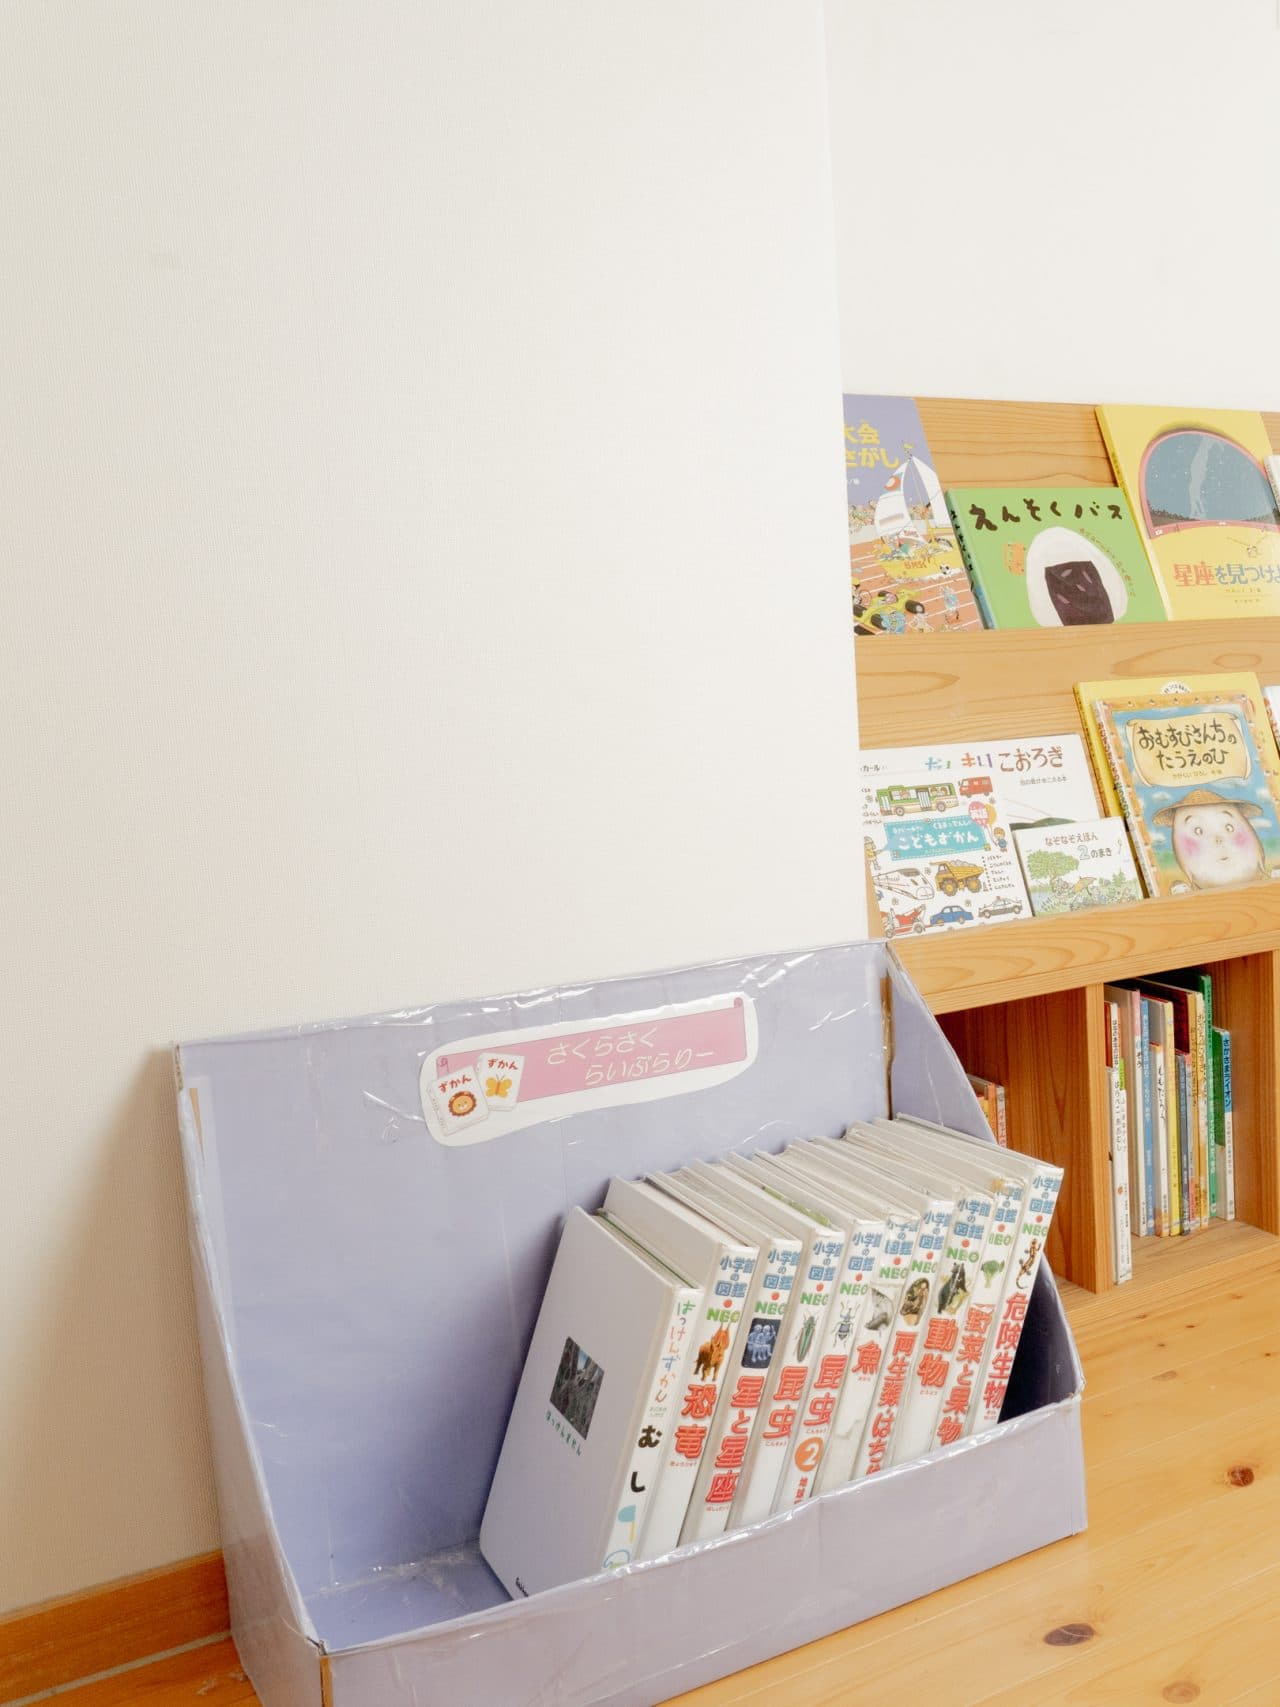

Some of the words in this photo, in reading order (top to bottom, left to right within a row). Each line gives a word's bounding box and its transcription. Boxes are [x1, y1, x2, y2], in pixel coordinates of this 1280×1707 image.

[969, 498, 1123, 532] えんそくバス
[1138, 717, 1238, 751] おむすびさんちの
[1156, 748, 1229, 771] たうえのひ
[1045, 832, 1099, 846] なぞなぞえほん
[487, 1056, 519, 1071] ずかん
[546, 1027, 659, 1065] さくらさく
[438, 1074, 473, 1094] ずかん
[584, 1048, 715, 1087] らいぶらりー
[879, 1267, 910, 1280] NEO
[946, 1246, 980, 1263] NEO
[655, 1300, 697, 1403] はっけんずかん
[852, 1340, 882, 1375] 魚
[917, 1317, 959, 1388] 動物
[983, 1291, 1028, 1409] 危険生物
[803, 1354, 849, 1428] 昆虫
[937, 1302, 996, 1446] 野菜と果物
[675, 1383, 717, 1460] 恐竜
[763, 1365, 809, 1440] 昆虫
[705, 1375, 765, 1503] 星と星座
[803, 1442, 820, 1466] 2
[631, 1424, 663, 1494] むし
